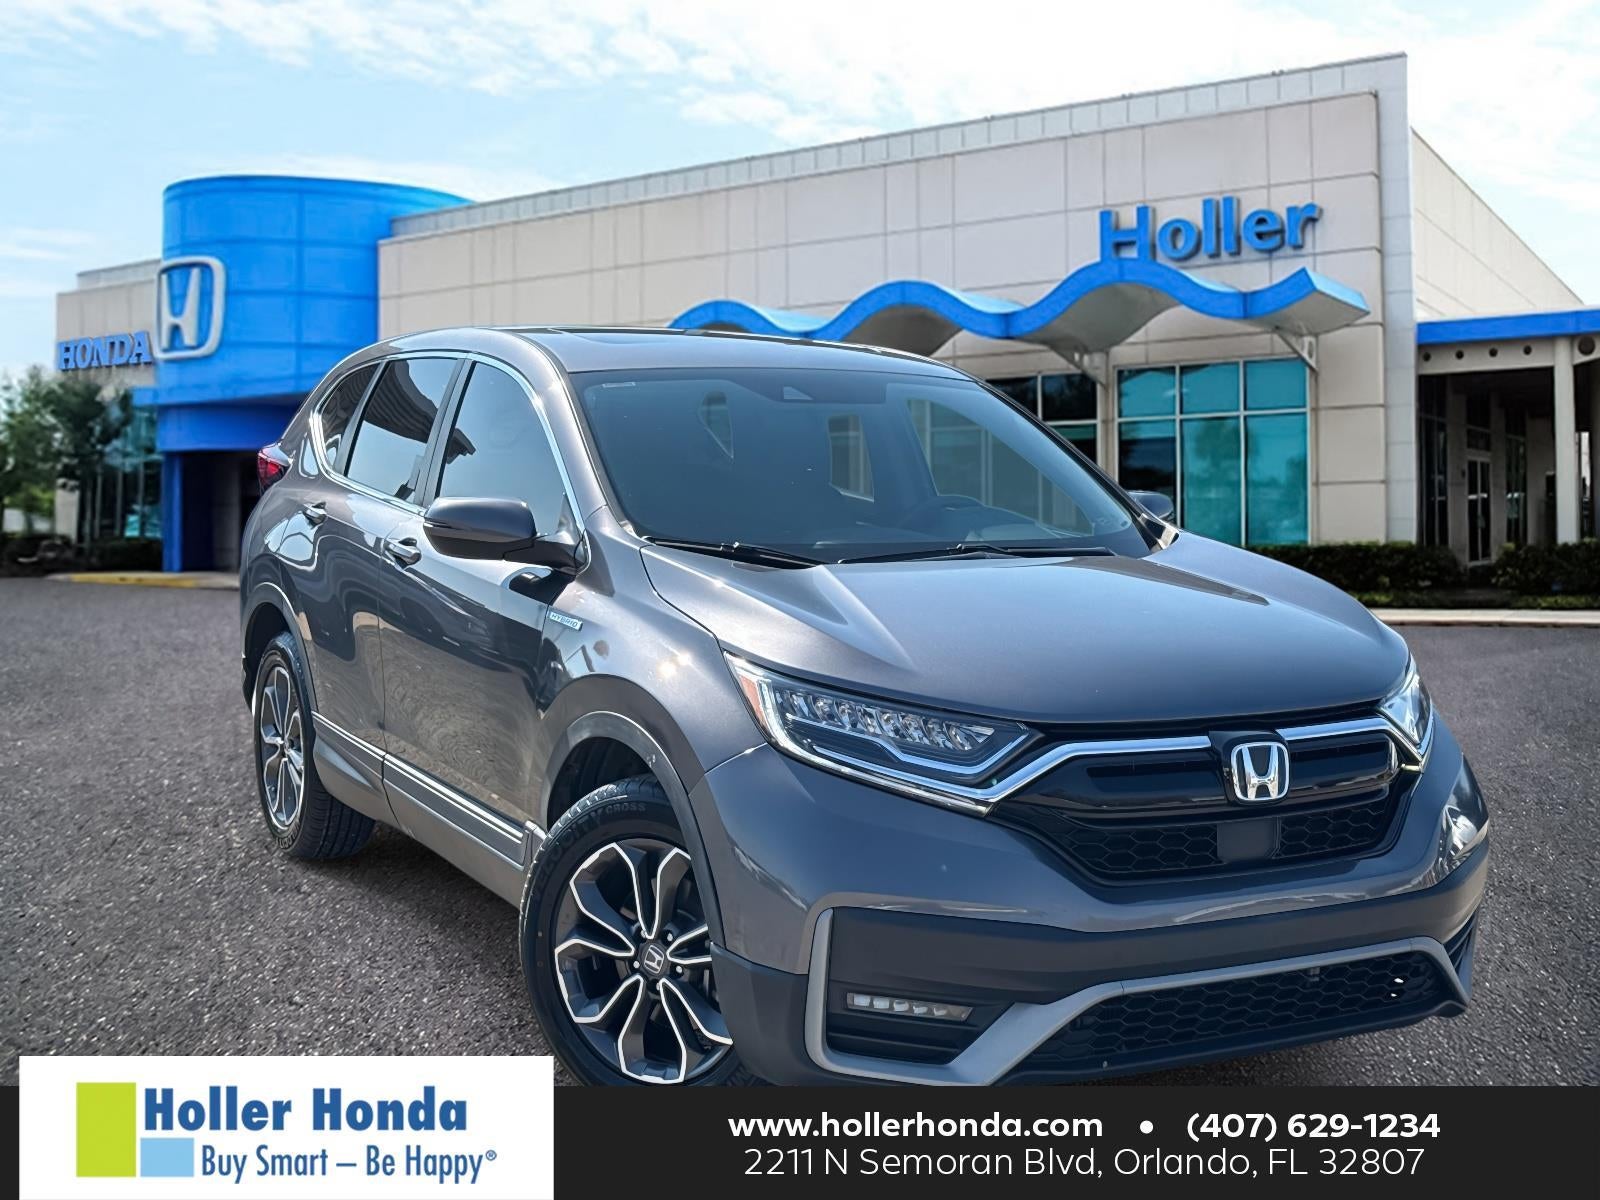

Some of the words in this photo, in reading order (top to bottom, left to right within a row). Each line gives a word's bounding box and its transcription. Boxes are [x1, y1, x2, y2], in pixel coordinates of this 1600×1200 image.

[1098, 196, 1322, 261] Holler
[57, 330, 152, 371] HONDA
[550, 612, 579, 628] HYBRID
[605, 801, 647, 816] CROSS
